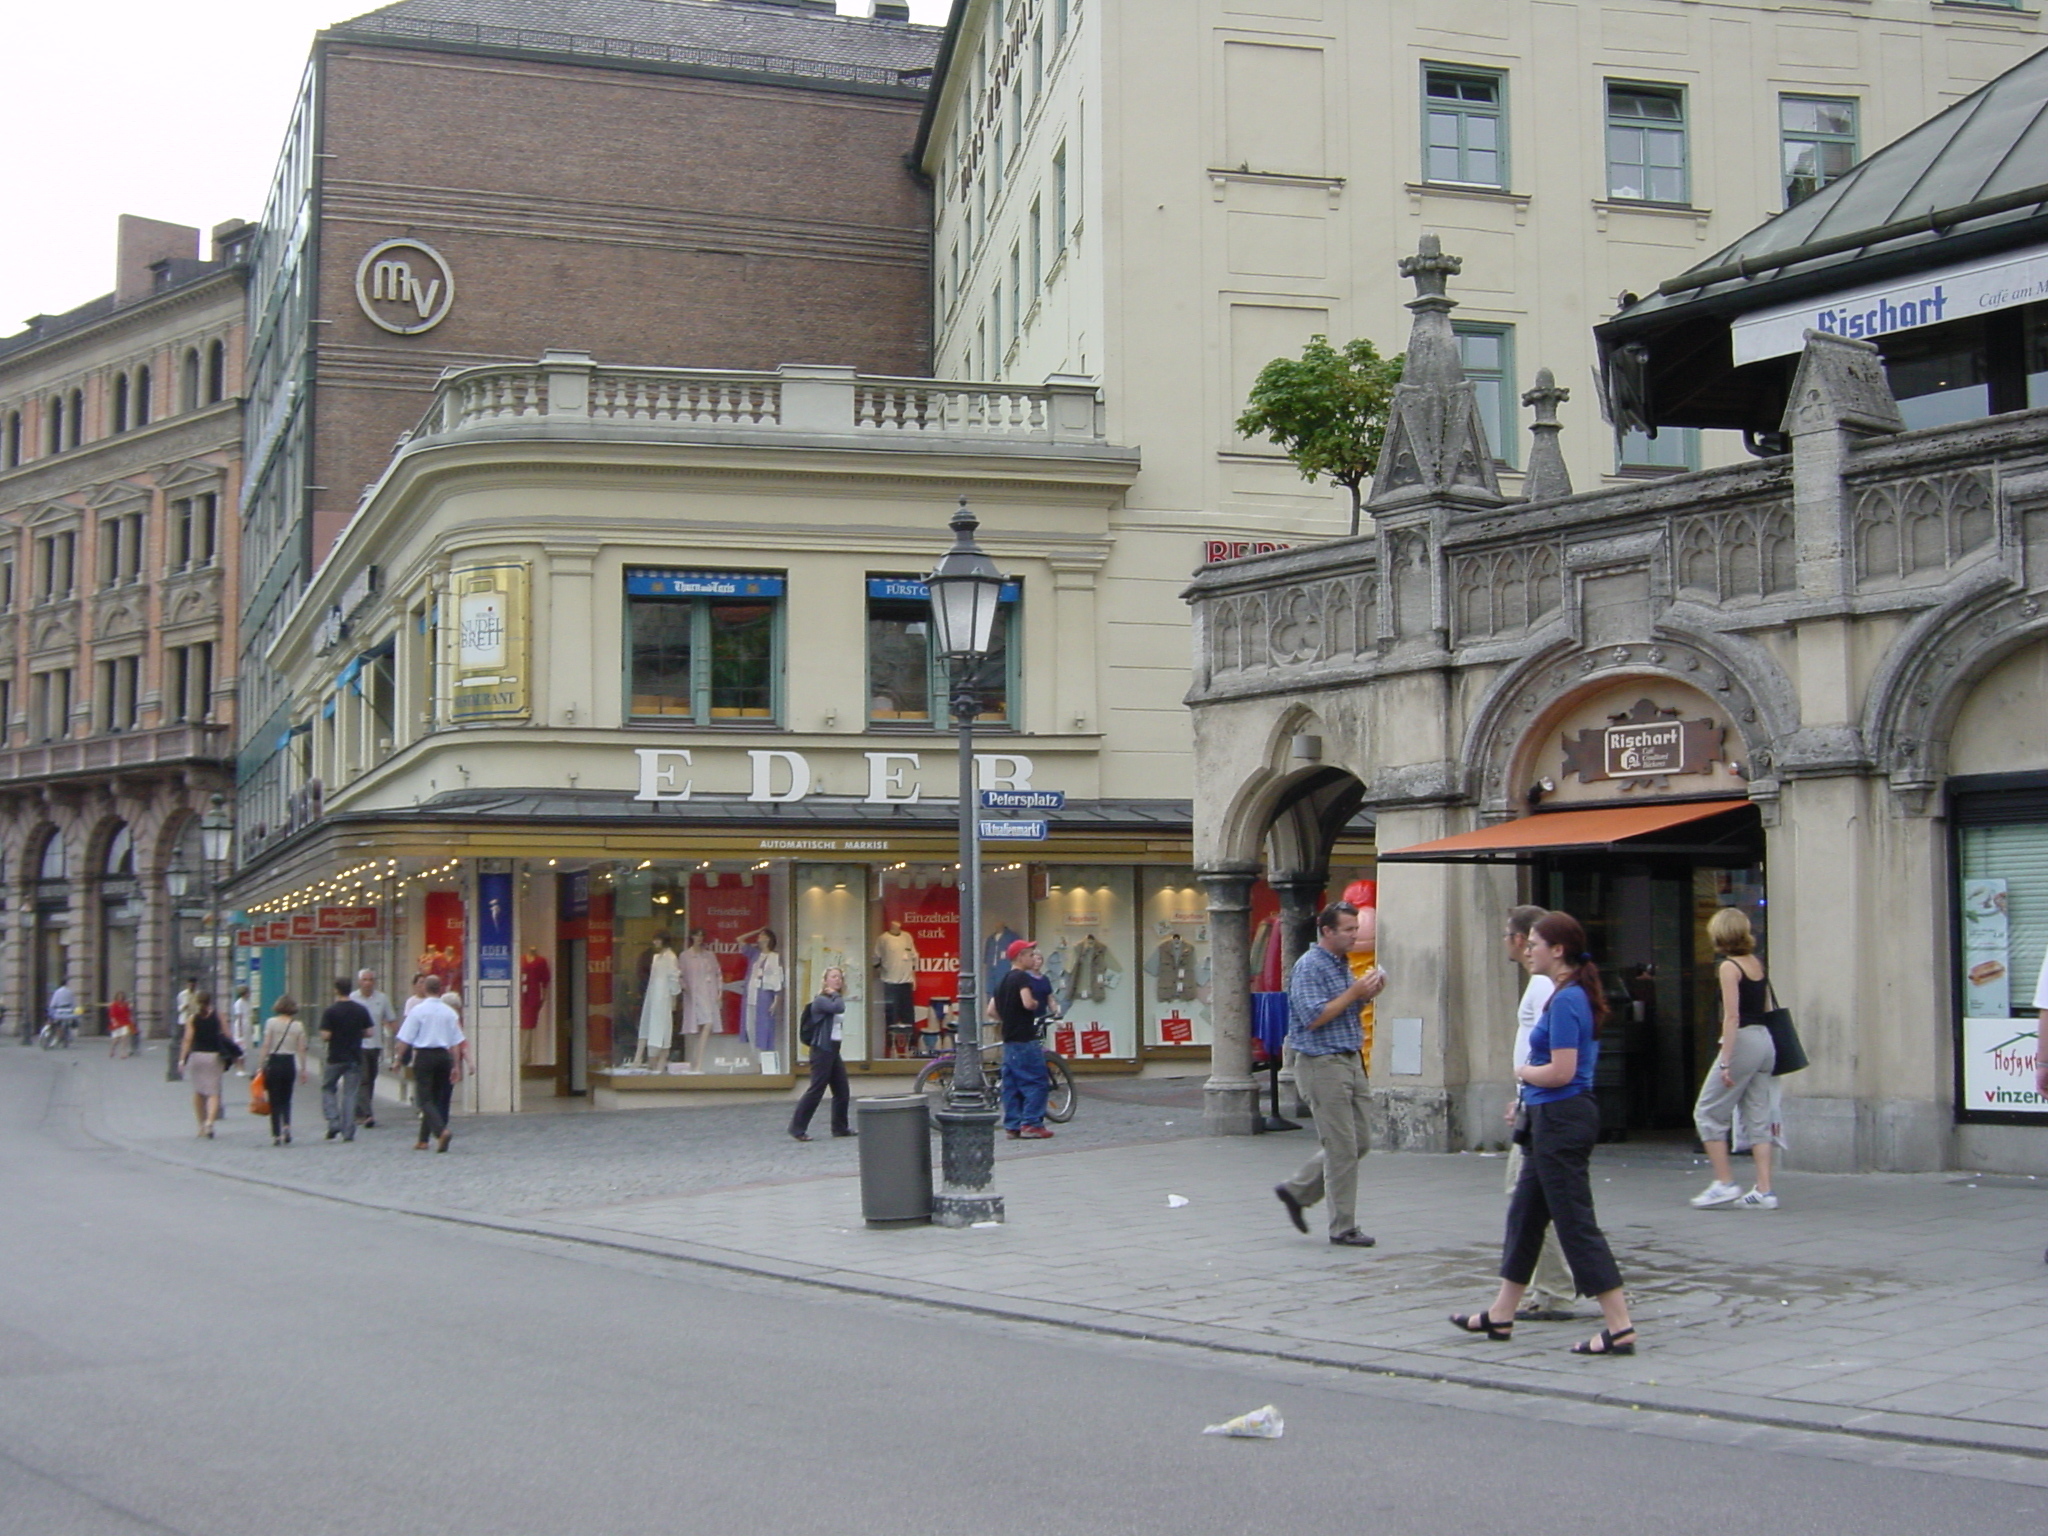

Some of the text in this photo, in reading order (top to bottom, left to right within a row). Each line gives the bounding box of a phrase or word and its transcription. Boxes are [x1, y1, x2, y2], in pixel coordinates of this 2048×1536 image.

[1818, 286, 1947, 339] Rischart
[2012, 287, 2033, 300] am
[886, 583, 918, 595] FÜRST
[1611, 729, 1677, 749] Rischart
[634, 748, 1034, 804] EDER
[988, 791, 1058, 808] Petersplatz
[760, 840, 889, 850] AUTOMATISCHE MARKISE
[904, 911, 960, 924] Einzelteile
[917, 927, 946, 939] stark
